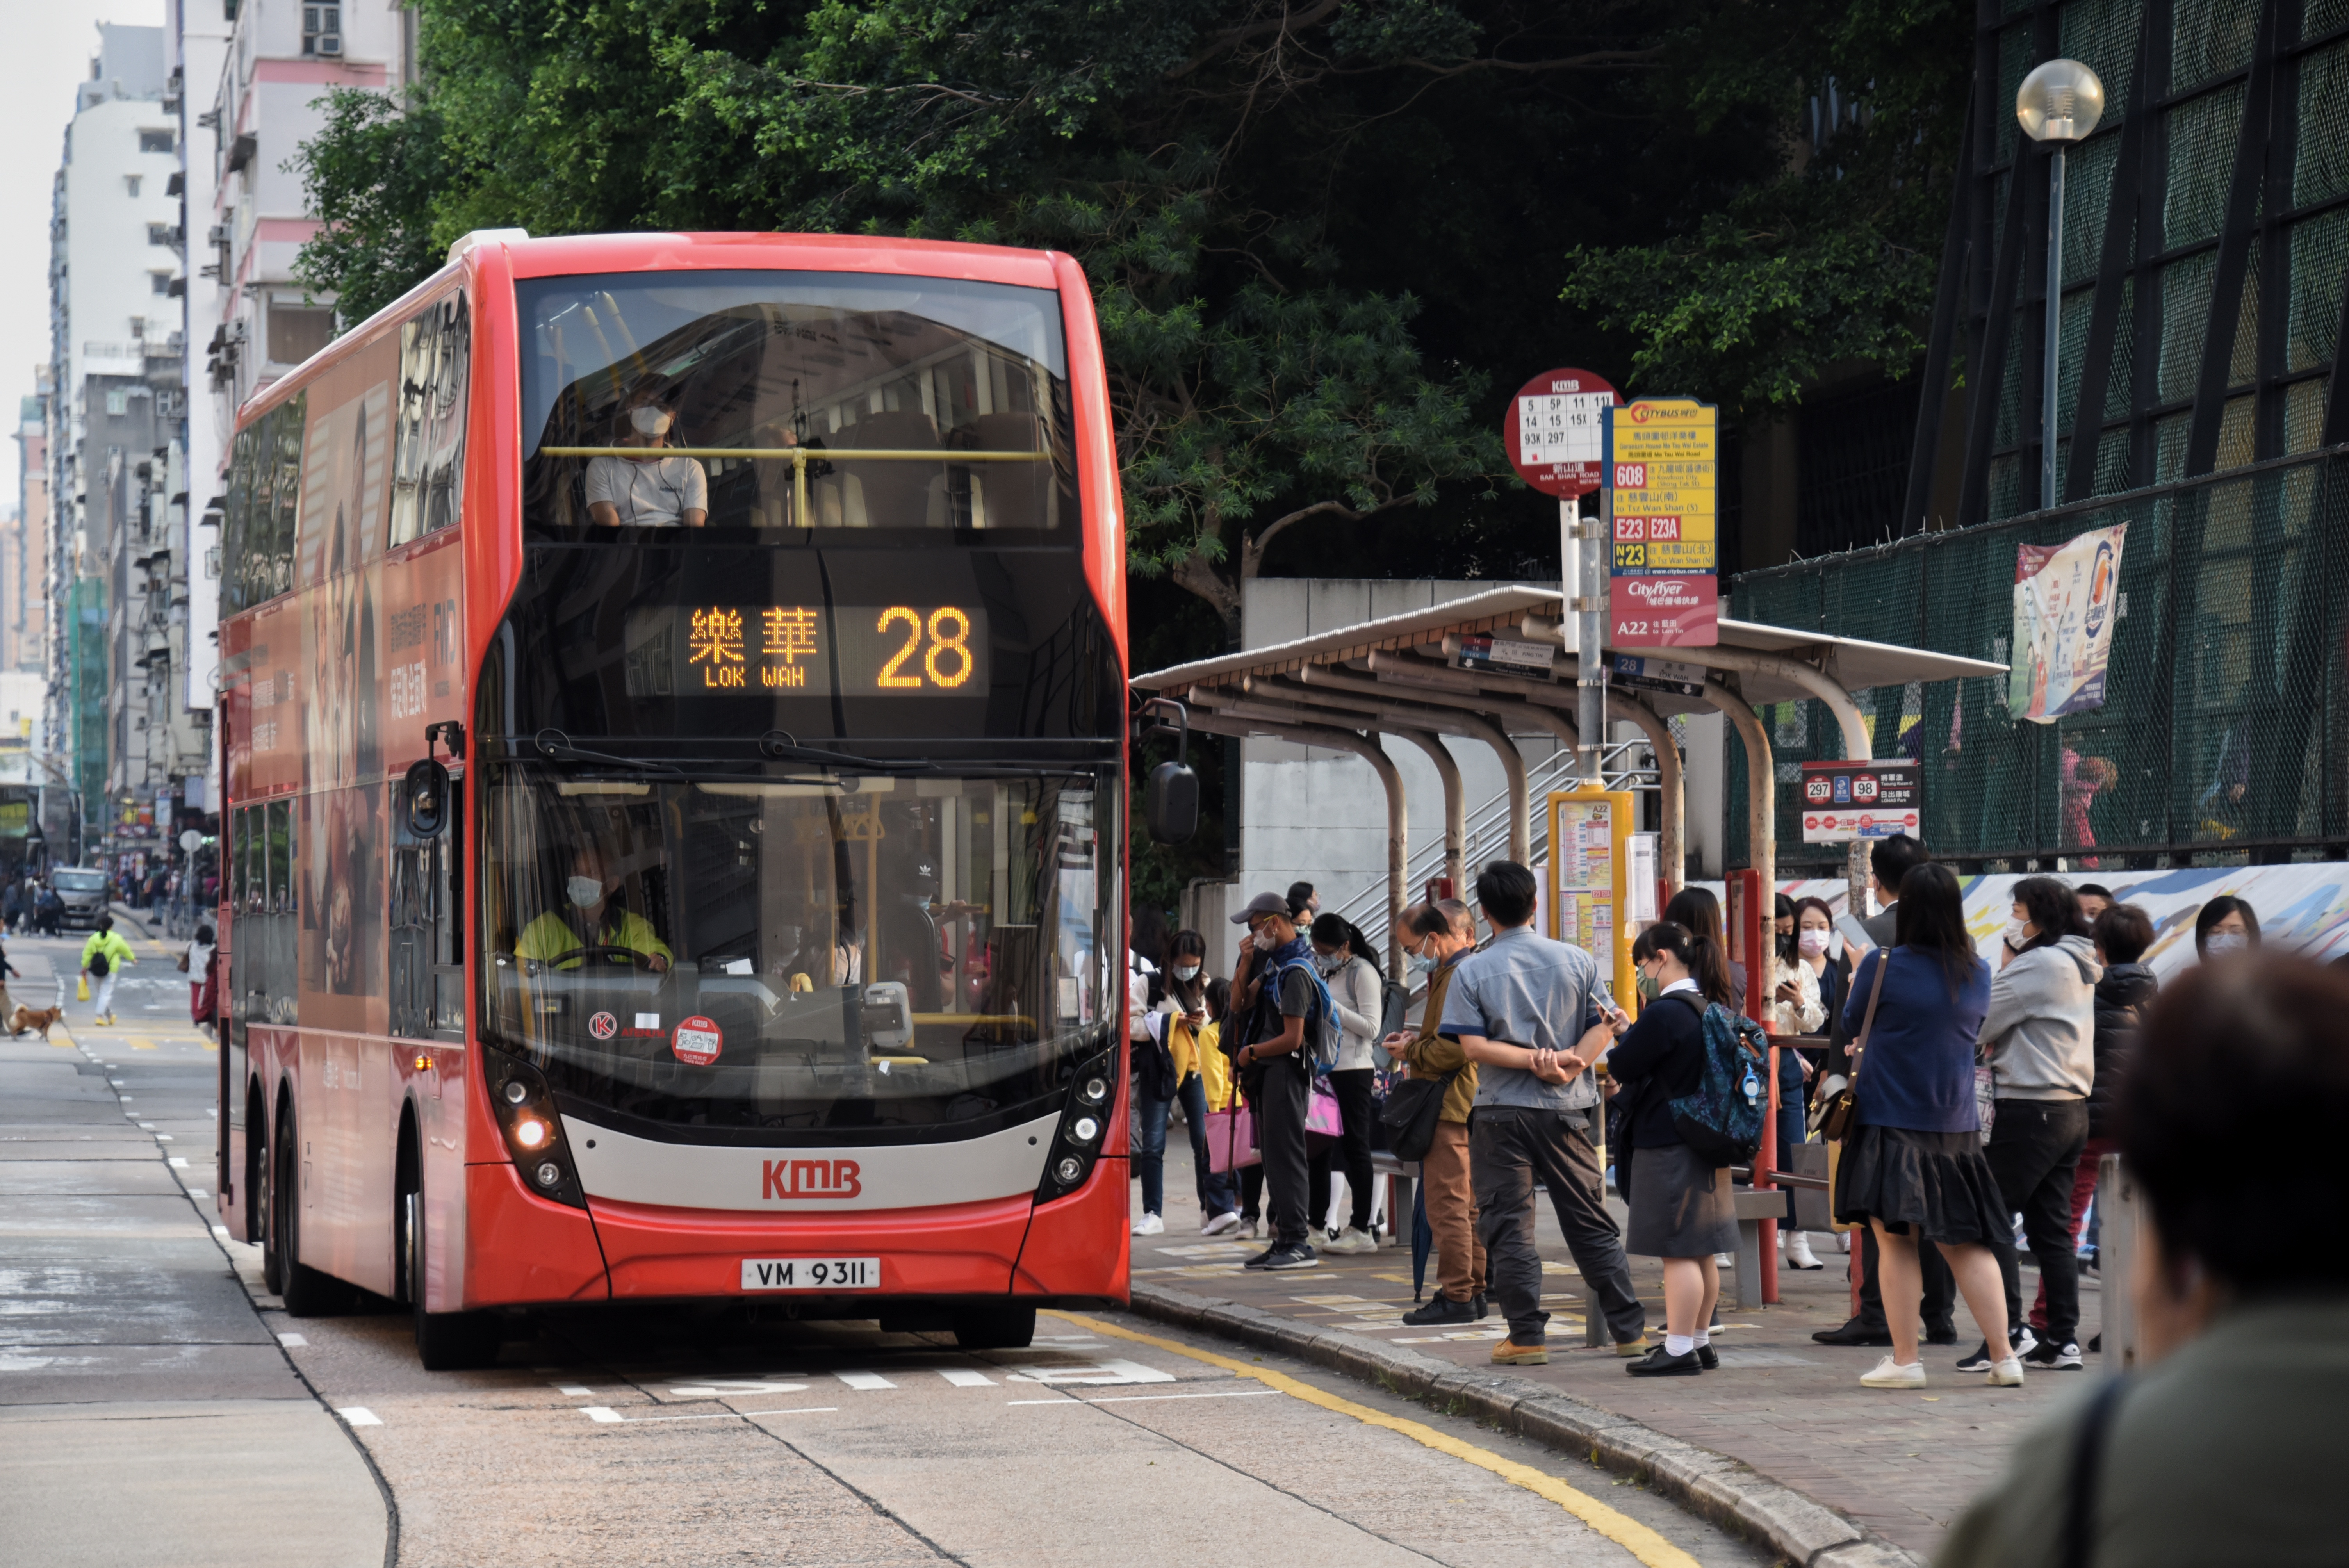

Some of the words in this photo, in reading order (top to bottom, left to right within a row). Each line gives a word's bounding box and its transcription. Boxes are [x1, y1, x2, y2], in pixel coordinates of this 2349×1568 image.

[1552, 380, 1579, 393] KMB
[1528, 399, 1533, 411] 5
[1550, 397, 1561, 410] 5P
[1573, 396, 1584, 408] 11
[1594, 395, 1610, 407] 11X
[1640, 409, 1679, 418] CITYBUS
[1680, 409, 1698, 418] 城巴
[1525, 415, 1537, 428] 14
[1549, 414, 1561, 426] 15
[1570, 413, 1586, 425] 15X
[1525, 433, 1540, 445] 93K
[1548, 431, 1564, 444] 297
[1553, 462, 1585, 474] 新山道
[1617, 465, 1643, 486] 608
[1616, 494, 1624, 502] 往
[1628, 491, 1678, 503] 慈雲山(南)
[1686, 503, 1698, 512] (S)
[1616, 518, 1643, 539] E23
[1651, 517, 1677, 538] E23A
[1650, 546, 1656, 555] 往
[1661, 543, 1711, 555] 慈雲山(北)
[1702, 556, 1713, 565] (N)
[1650, 596, 1699, 606] 城巴機場快線
[1618, 622, 1647, 635] A22
[1662, 619, 1677, 628] 藍田
[690, 606, 817, 664] 樂華
[877, 606, 972, 688] 28
[1620, 658, 1637, 672] 28
[705, 666, 745, 687] LOK
[762, 666, 804, 687] WAH
[1881, 773, 1903, 782] 將軍澳
[1809, 784, 1829, 796] 297
[1858, 782, 1873, 794] 98
[692, 1019, 708, 1028] KMB
[762, 1159, 862, 1199] KMB
[757, 1263, 793, 1285] VM
[811, 1262, 865, 1285] 9311
